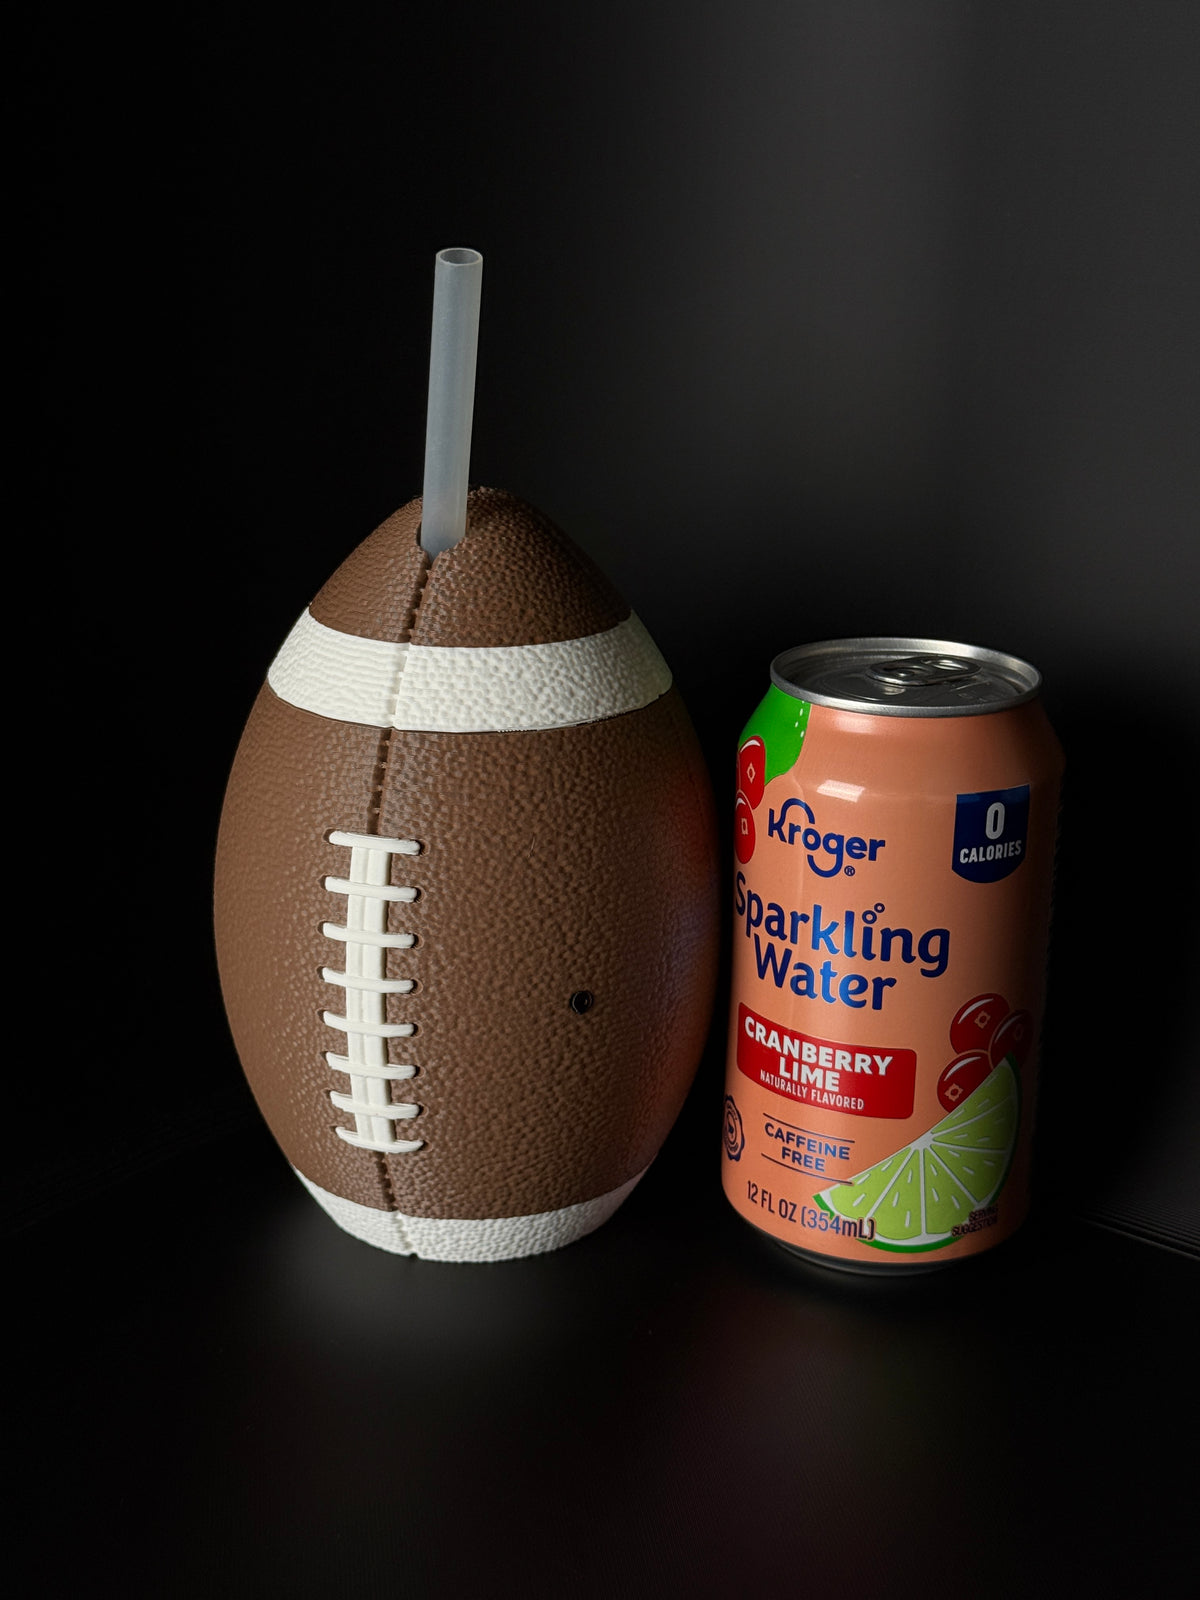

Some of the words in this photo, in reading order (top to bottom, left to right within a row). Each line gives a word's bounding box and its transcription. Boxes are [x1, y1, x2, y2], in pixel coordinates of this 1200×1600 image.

[767, 798, 886, 878] Kroger
[985, 802, 1006, 840] 0
[959, 839, 1022, 864] CALORIES
[735, 871, 951, 978] Sparkling
[754, 933, 897, 1011] Water
[744, 1016, 893, 1077] CRANBERRY
[760, 1069, 807, 1099] NATURALLY
[811, 1088, 864, 1111] FLAVORED
[779, 1057, 840, 1093] LIME
[764, 1122, 850, 1161] CAFFEINE
[781, 1146, 825, 1173] FREE
[747, 1180, 758, 1204] 12
[761, 1190, 774, 1214] FL
[779, 1200, 797, 1223] OZ
[801, 1206, 876, 1240] (354mL)
